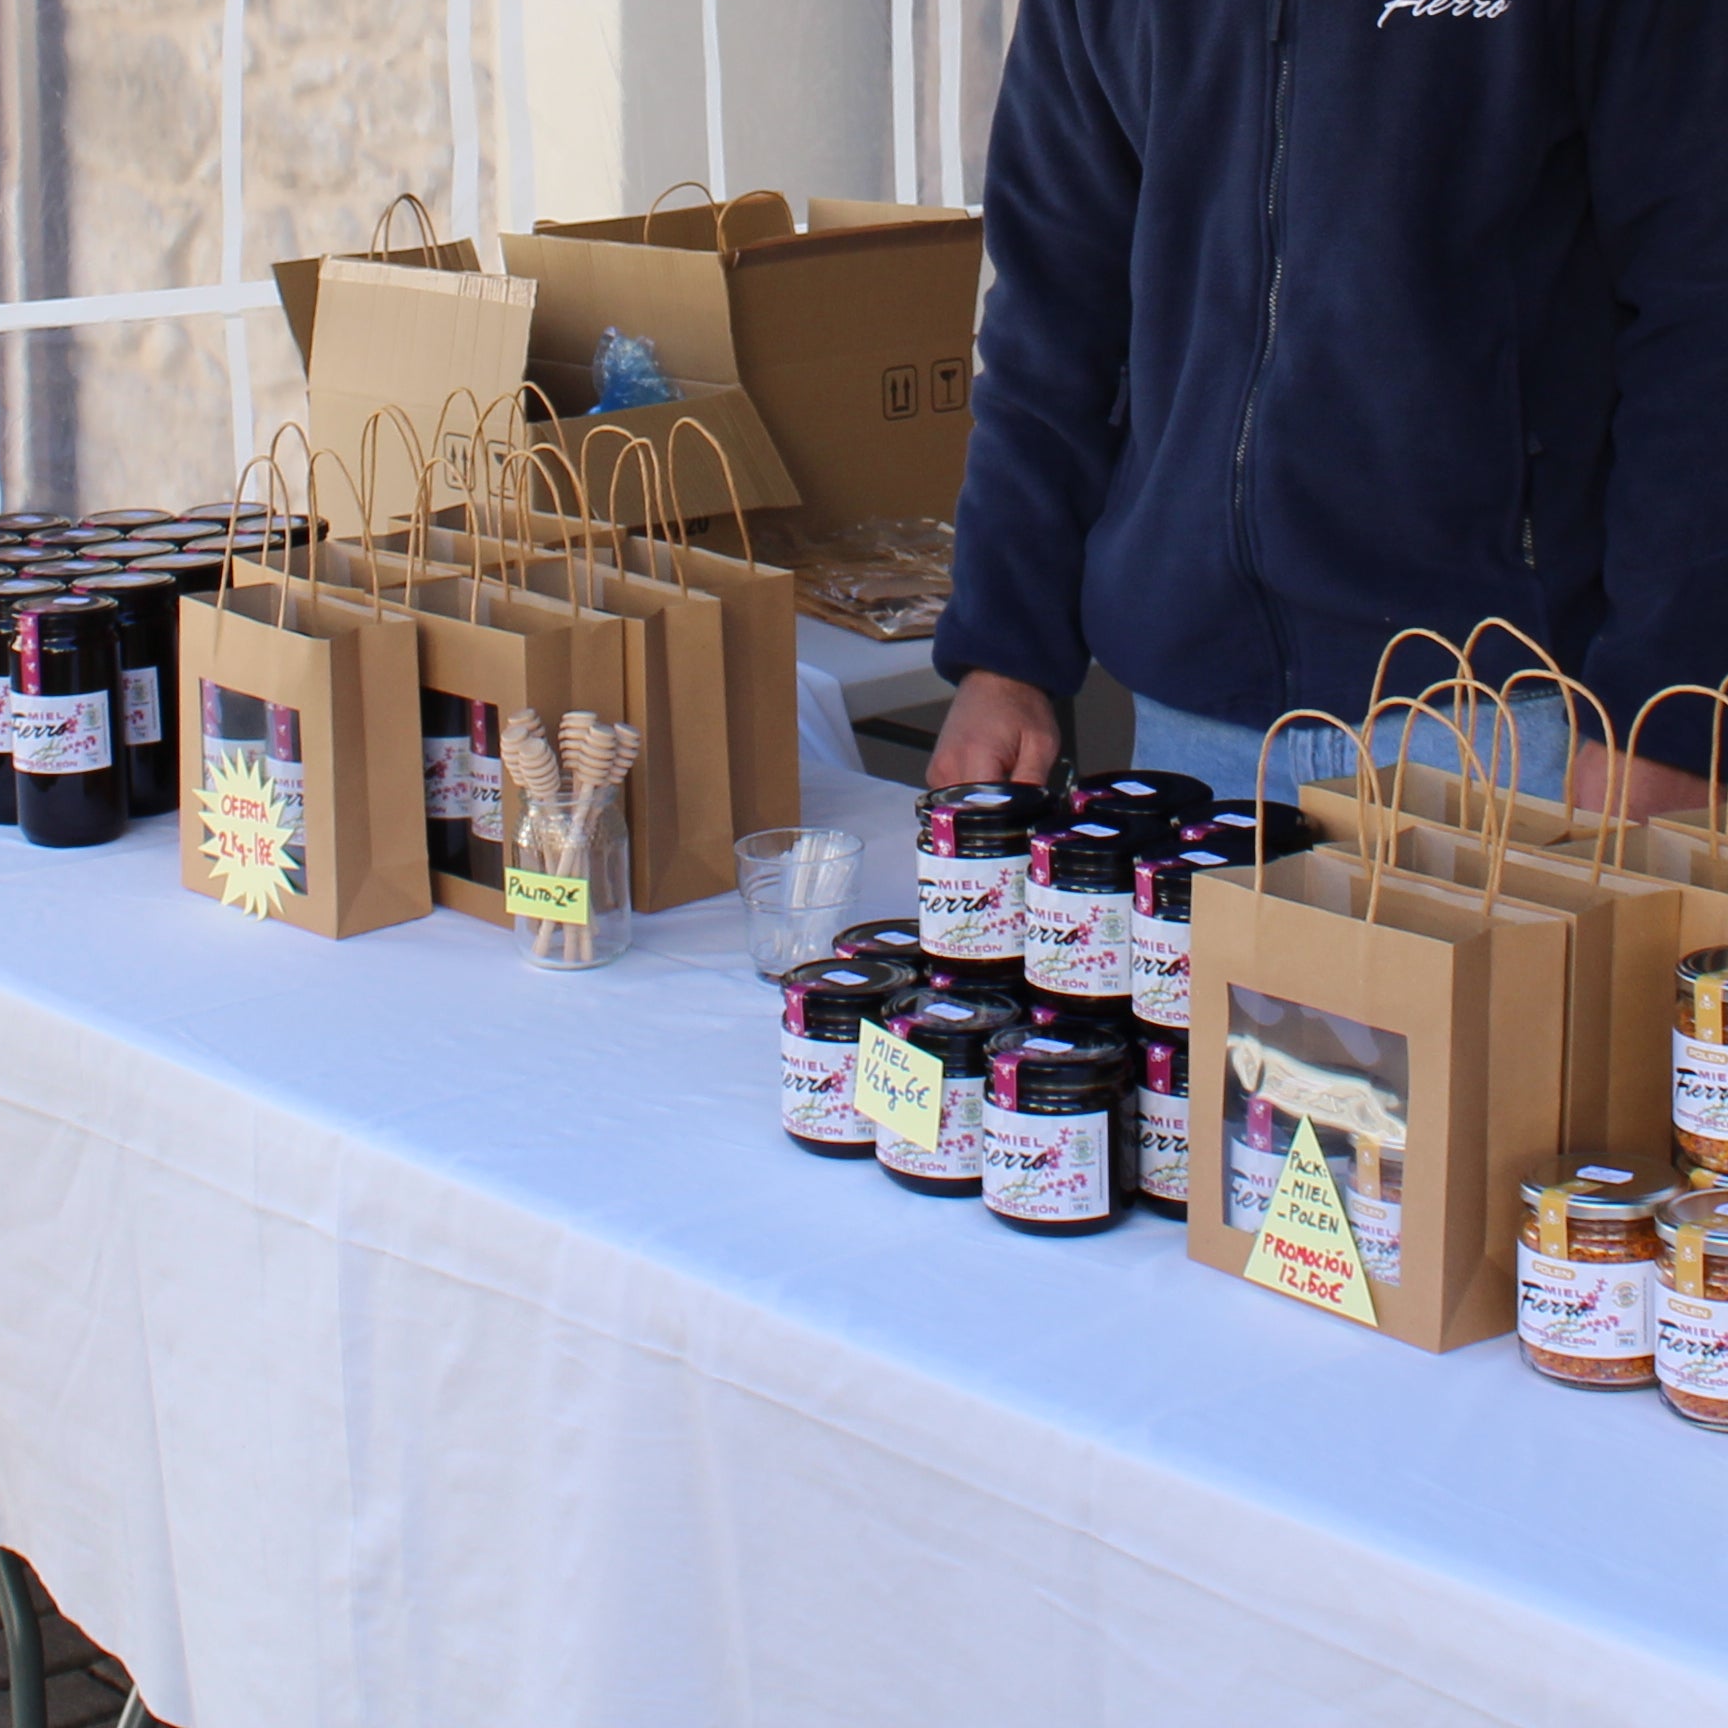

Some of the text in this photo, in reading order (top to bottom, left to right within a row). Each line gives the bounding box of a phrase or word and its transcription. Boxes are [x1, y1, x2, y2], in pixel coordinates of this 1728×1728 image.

[27, 712, 66, 721] MIEL
[278, 778, 304, 790] MIE
[474, 772, 499, 784] MIE
[221, 793, 269, 824] OFERTA
[938, 879, 987, 891] MIEL
[1034, 907, 1076, 924] MIEL
[1138, 937, 1179, 955] MIEL
[871, 1036, 911, 1072] MIEL
[1688, 1048, 1727, 1063] POLEN
[790, 1055, 827, 1073] MIEL
[1150, 1115, 1185, 1130] MIE
[997, 1131, 1044, 1148] MIEL
[1289, 1150, 1328, 1179] PACK:
[1534, 1262, 1573, 1279] POLEN
[1277, 1263, 1344, 1304] 12,50€
[1545, 1284, 1582, 1298] MIEL
[1521, 1280, 1589, 1317] Fierro
[1670, 1301, 1709, 1318] POLEN
[1658, 1319, 1726, 1356] Fierro
[1680, 1323, 1718, 1338] MIEL
